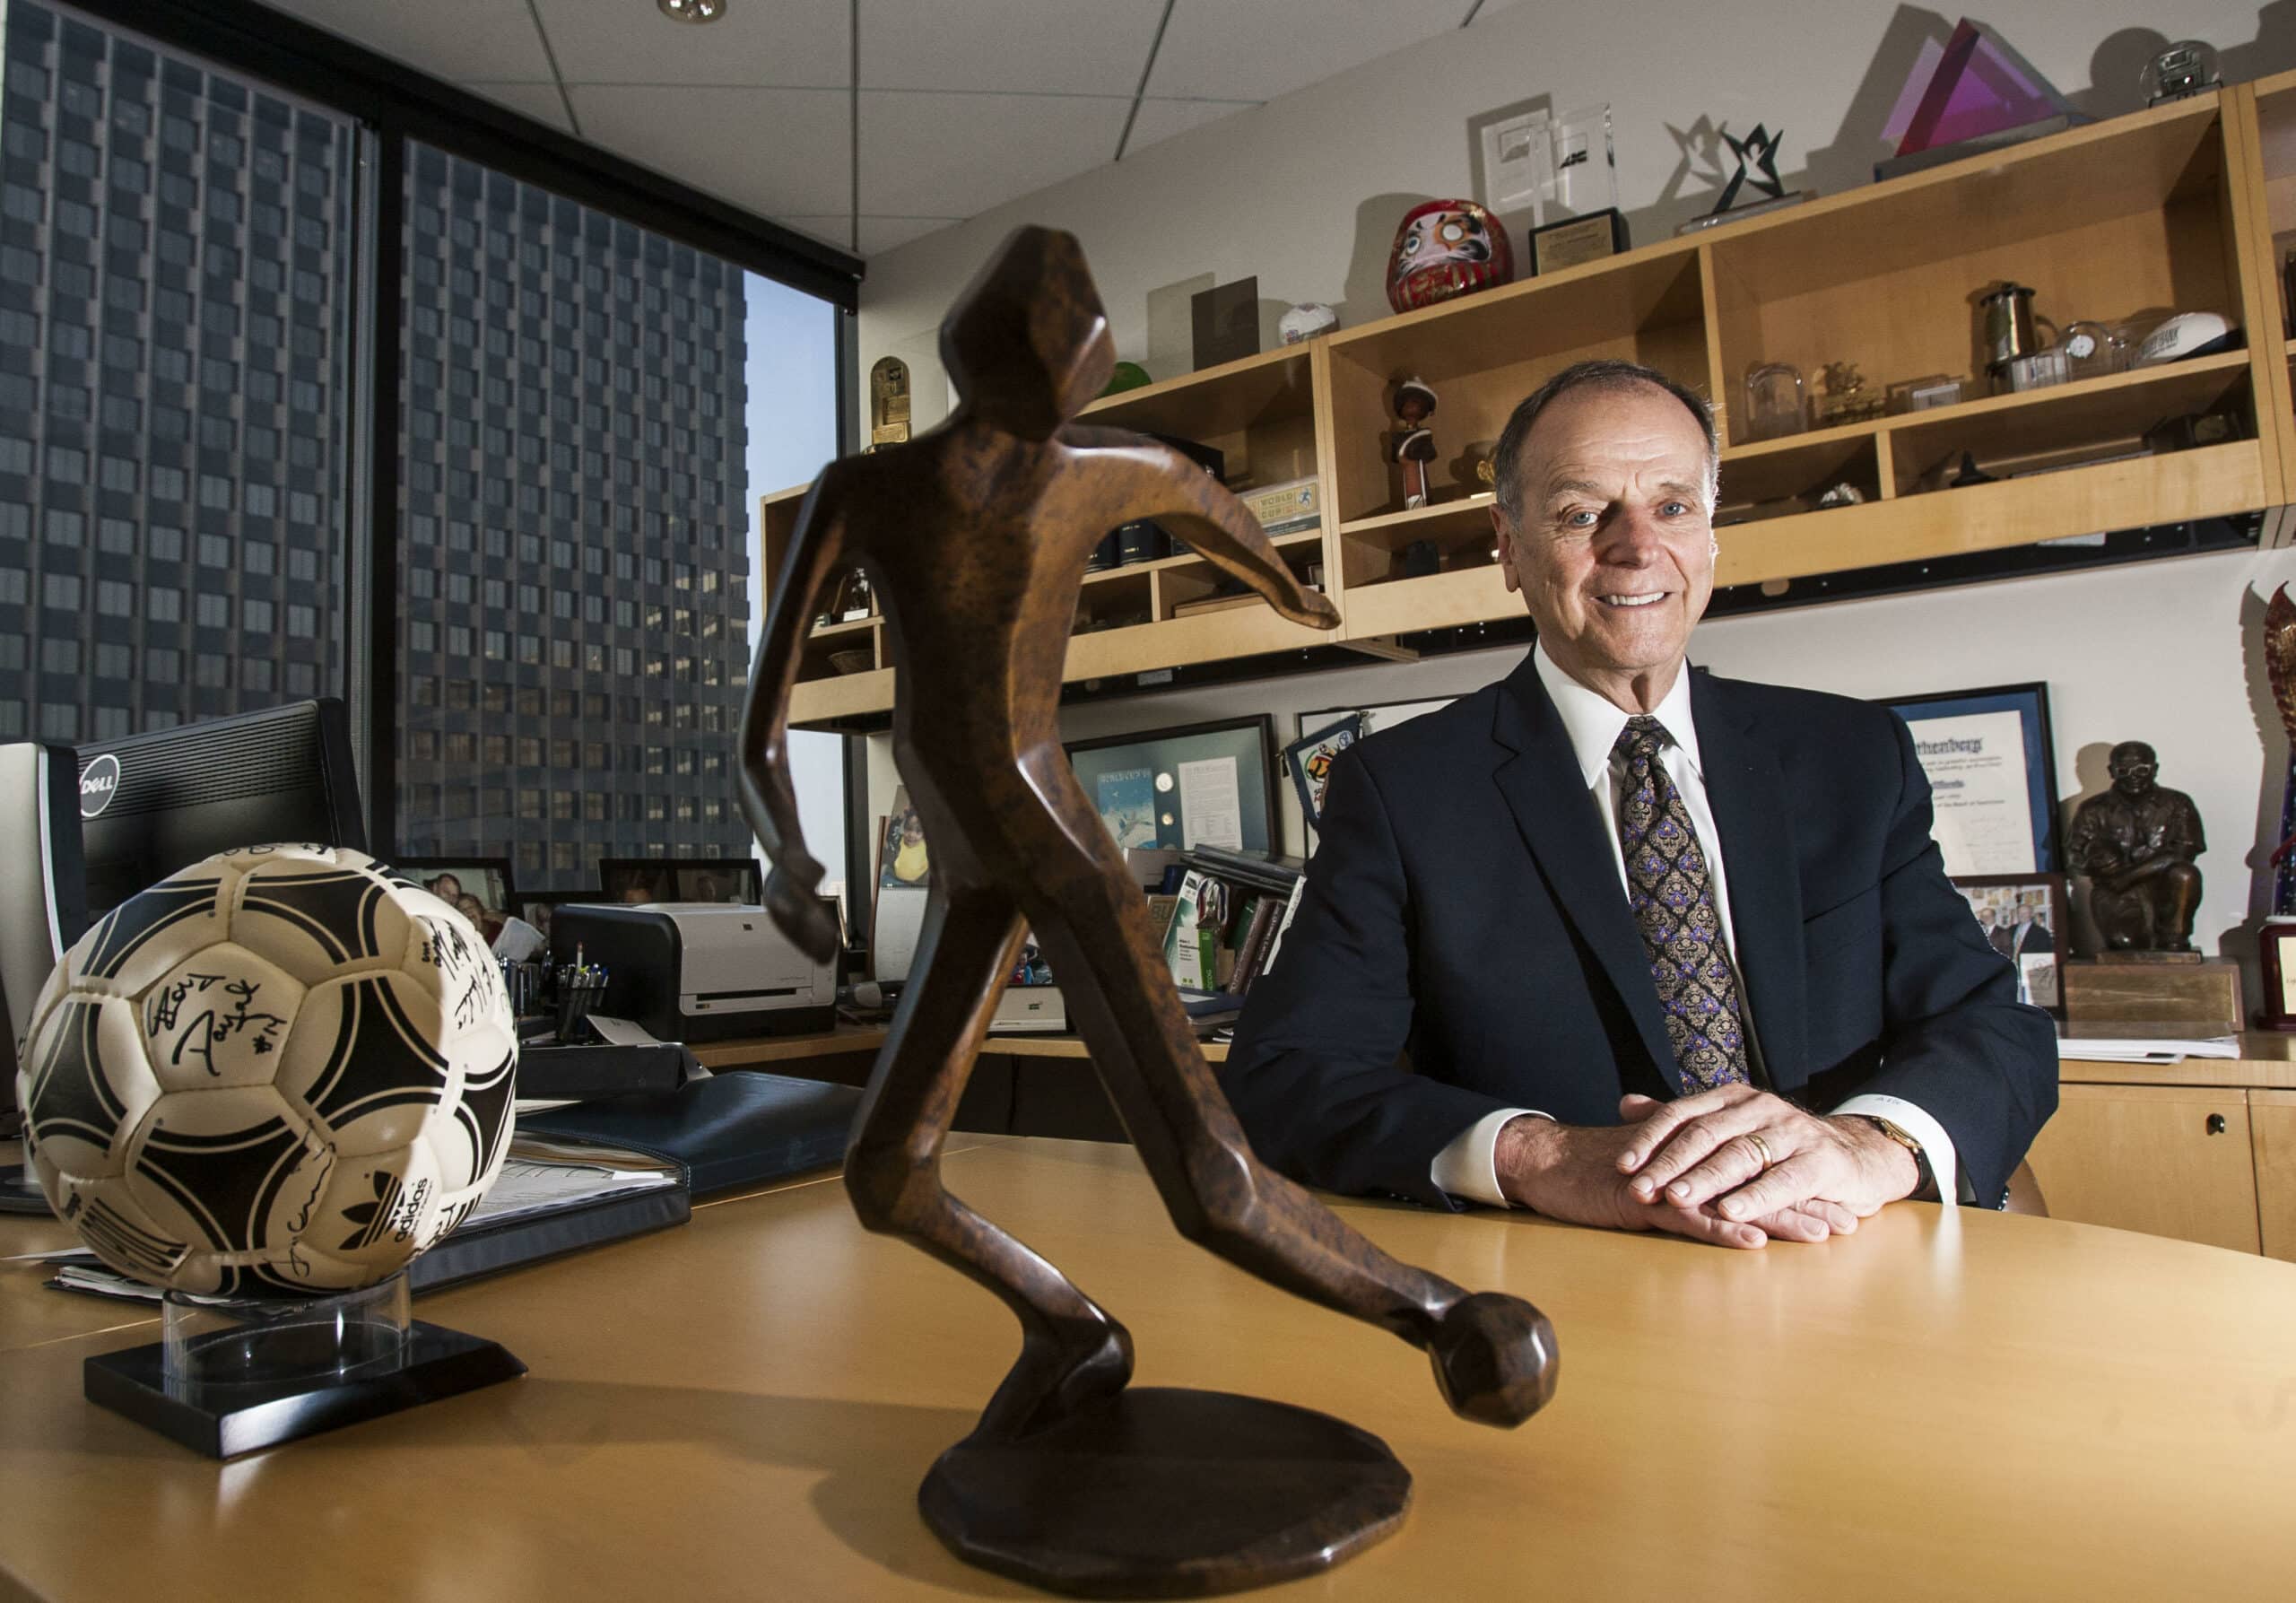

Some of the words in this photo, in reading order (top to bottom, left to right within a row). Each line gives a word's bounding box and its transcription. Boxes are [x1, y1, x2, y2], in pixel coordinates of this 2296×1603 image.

[1261, 492, 1293, 506] WORLD
[1262, 507, 1283, 518] CUP
[81, 775, 113, 795] DELL
[395, 1177, 428, 1243] adidas
